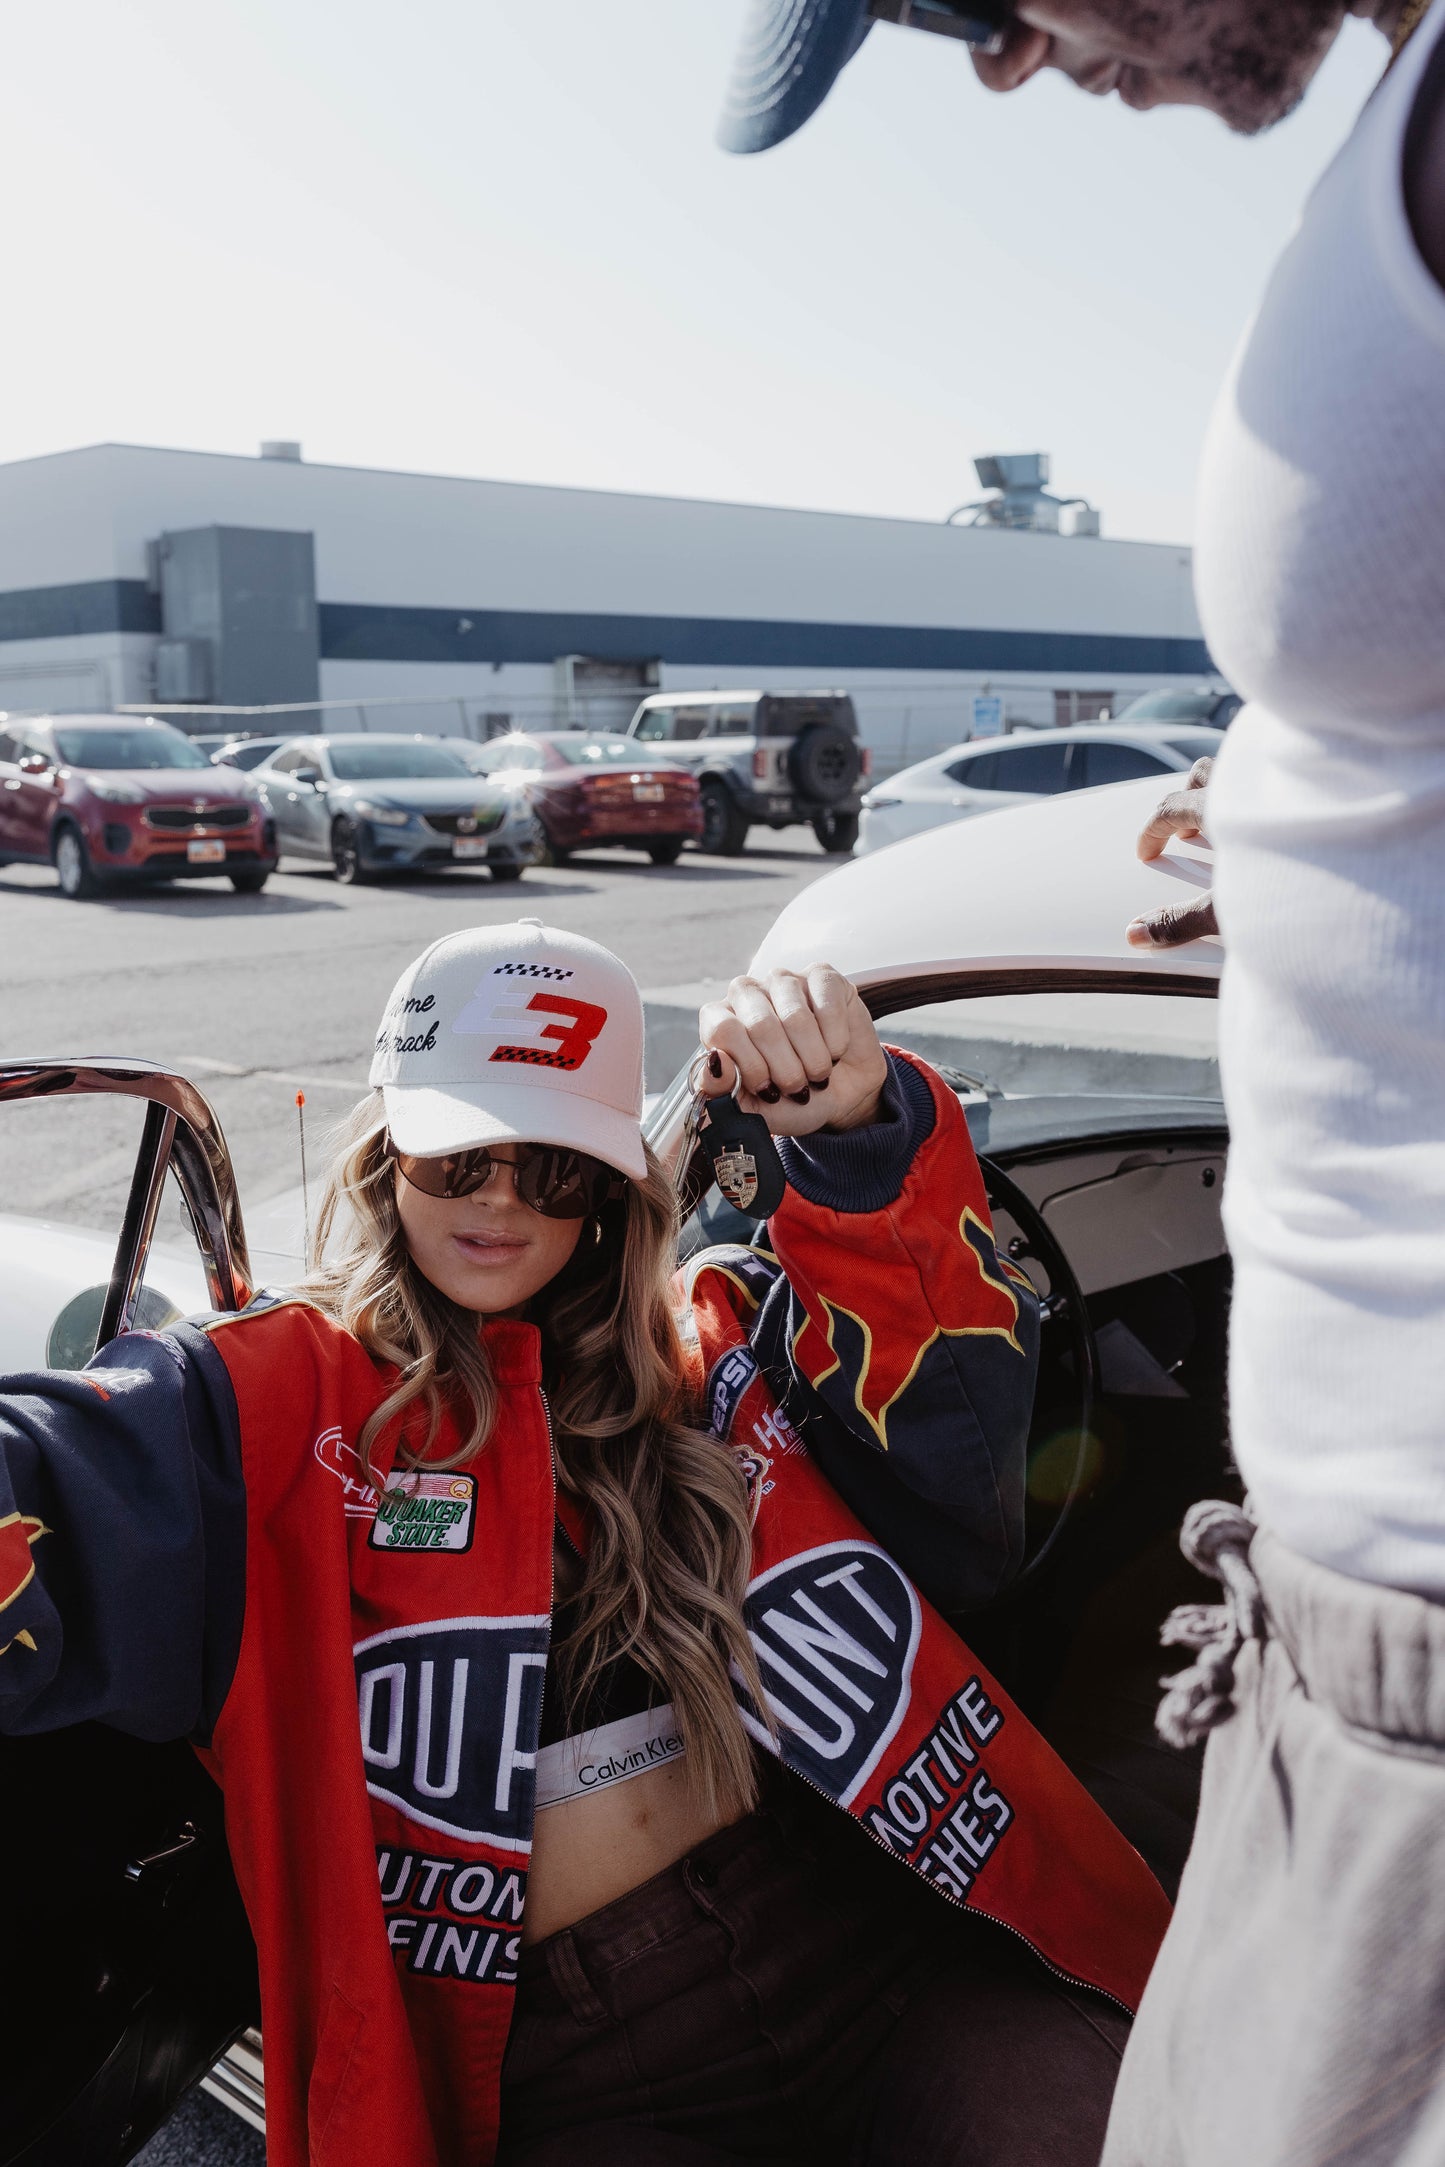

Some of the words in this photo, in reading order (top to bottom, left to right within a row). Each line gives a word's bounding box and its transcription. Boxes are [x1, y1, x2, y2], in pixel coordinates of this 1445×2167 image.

[377, 1488, 468, 1526] QUAKER
[386, 1522, 451, 1547] STATE
[578, 1750, 646, 1786] Calvin
[645, 1729, 685, 1760] Klei
